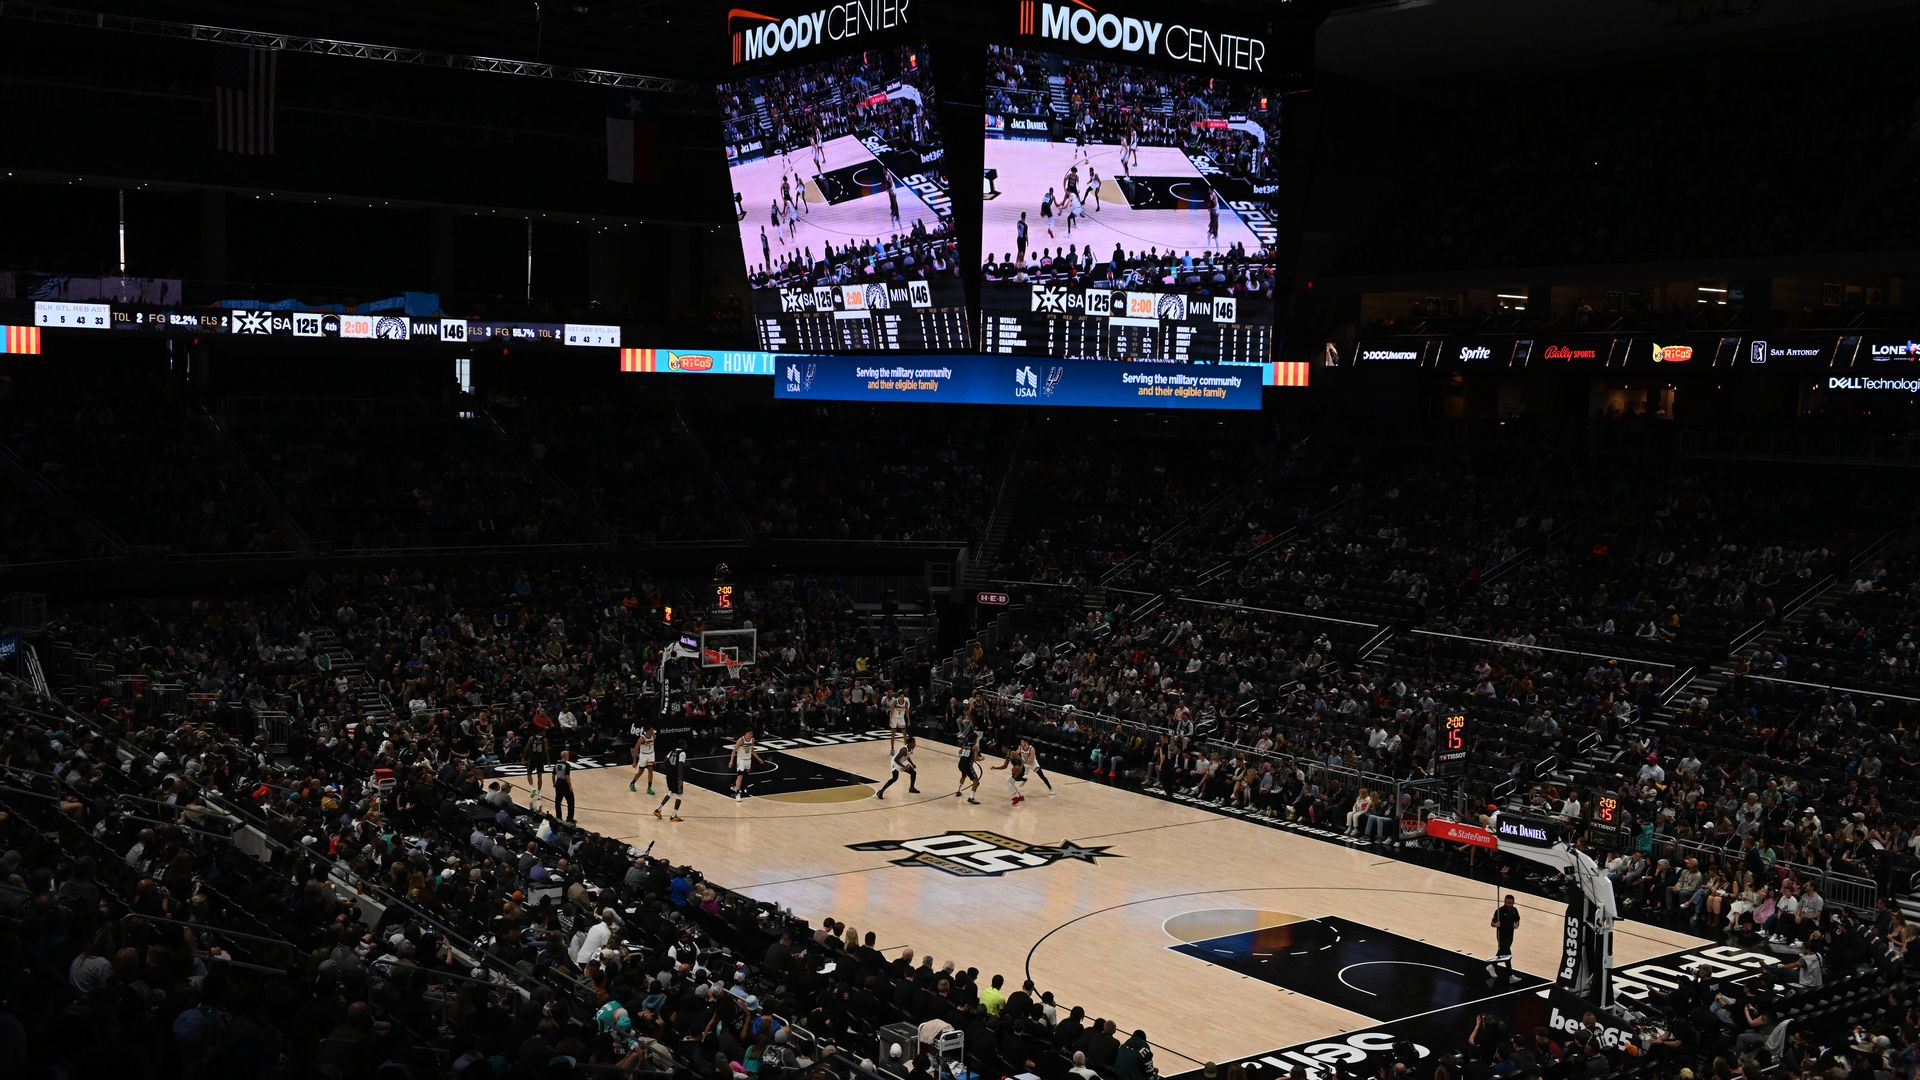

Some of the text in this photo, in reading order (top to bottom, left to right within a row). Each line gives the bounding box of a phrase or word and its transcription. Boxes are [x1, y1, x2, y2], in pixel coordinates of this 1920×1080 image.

[745, 9, 826, 61] MOODY
[1041, 3, 1265, 73] MOODY CENTER
[803, 293, 814, 306] SA
[816, 290, 832, 308] 125
[846, 291, 862, 305] 2:00
[890, 288, 908, 302] MIN
[911, 286, 928, 304] 146
[1067, 294, 1084, 308] SA
[1088, 294, 1109, 312] 125
[1131, 299, 1152, 313] 2:00
[1189, 302, 1211, 315] MIN
[1215, 302, 1233, 319] 146
[95, 317, 103, 325] 33
[113, 312, 130, 321] TOL
[136, 313, 143, 323] 2
[149, 314, 165, 322] FG
[201, 316, 217, 325] FLS
[222, 317, 227, 326] 2
[273, 318, 291, 330] SA
[296, 318, 318, 334] 125
[325, 323, 337, 331] 4th
[345, 321, 368, 334] 2:00
[413, 324, 437, 335] MIN
[443, 324, 464, 339] 146
[468, 327, 482, 335] FLS
[486, 327, 491, 336] 3
[495, 328, 509, 336] FG
[539, 330, 552, 338] TOL
[555, 330, 560, 339] 2
[1459, 346, 1490, 362] Sprite
[1545, 345, 1595, 362] Bally SPORTS
[1872, 344, 1906, 355] LONE
[724, 353, 756, 372] HOW
[856, 367, 952, 380] Serving the military community
[1122, 372, 1241, 388] Serving the military community
[787, 384, 800, 392] USAA
[867, 379, 939, 392] and their eligible family
[1829, 377, 1862, 389] DELL
[1016, 387, 1037, 398] USAA
[1138, 385, 1226, 399] and their eligible family
[717, 586, 732, 595] 2:00
[718, 595, 730, 608] 15
[1446, 715, 1464, 729] 2:00
[1448, 729, 1462, 749] 15
[1446, 752, 1467, 760] TISSOT
[1600, 796, 1617, 809] 2:00
[1602, 808, 1613, 821] 15
[1500, 821, 1547, 841] JACK DANIEL'S
[1560, 916, 1579, 980] bet365
